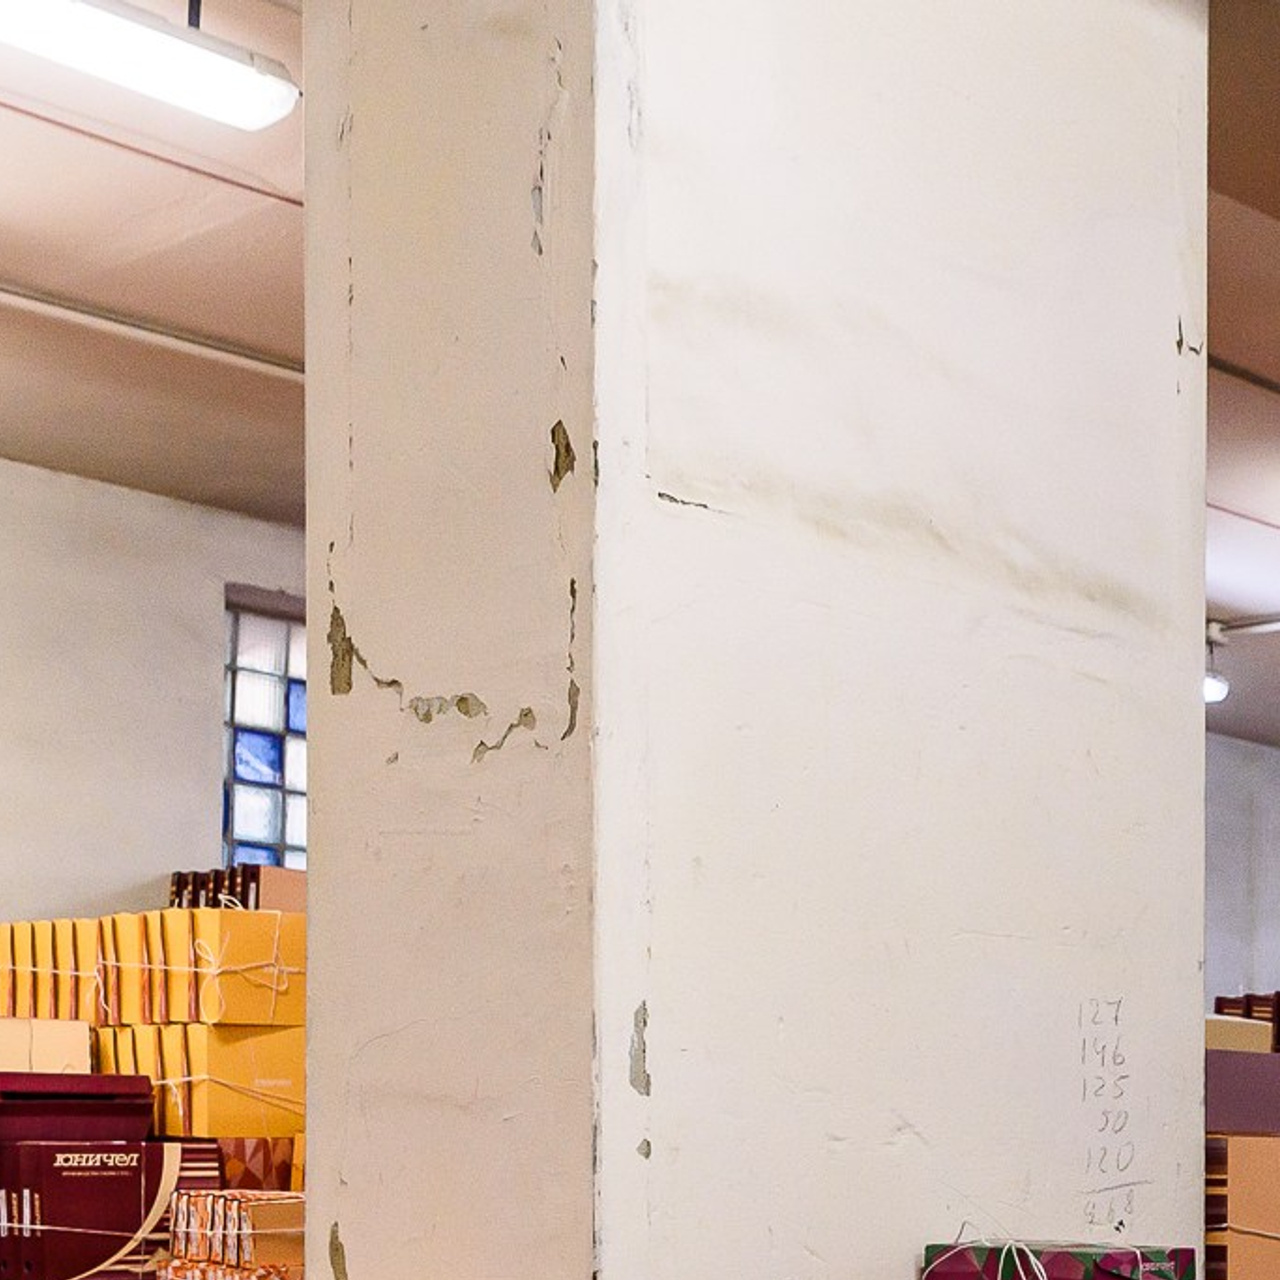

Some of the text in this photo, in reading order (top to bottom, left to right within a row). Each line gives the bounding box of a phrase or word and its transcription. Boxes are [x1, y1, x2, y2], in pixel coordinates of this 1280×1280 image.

[1077, 996, 1123, 1029] 127
[1080, 1036, 1126, 1067] 146
[1081, 1074, 1130, 1102] 125
[1097, 1110, 1129, 1135] 50
